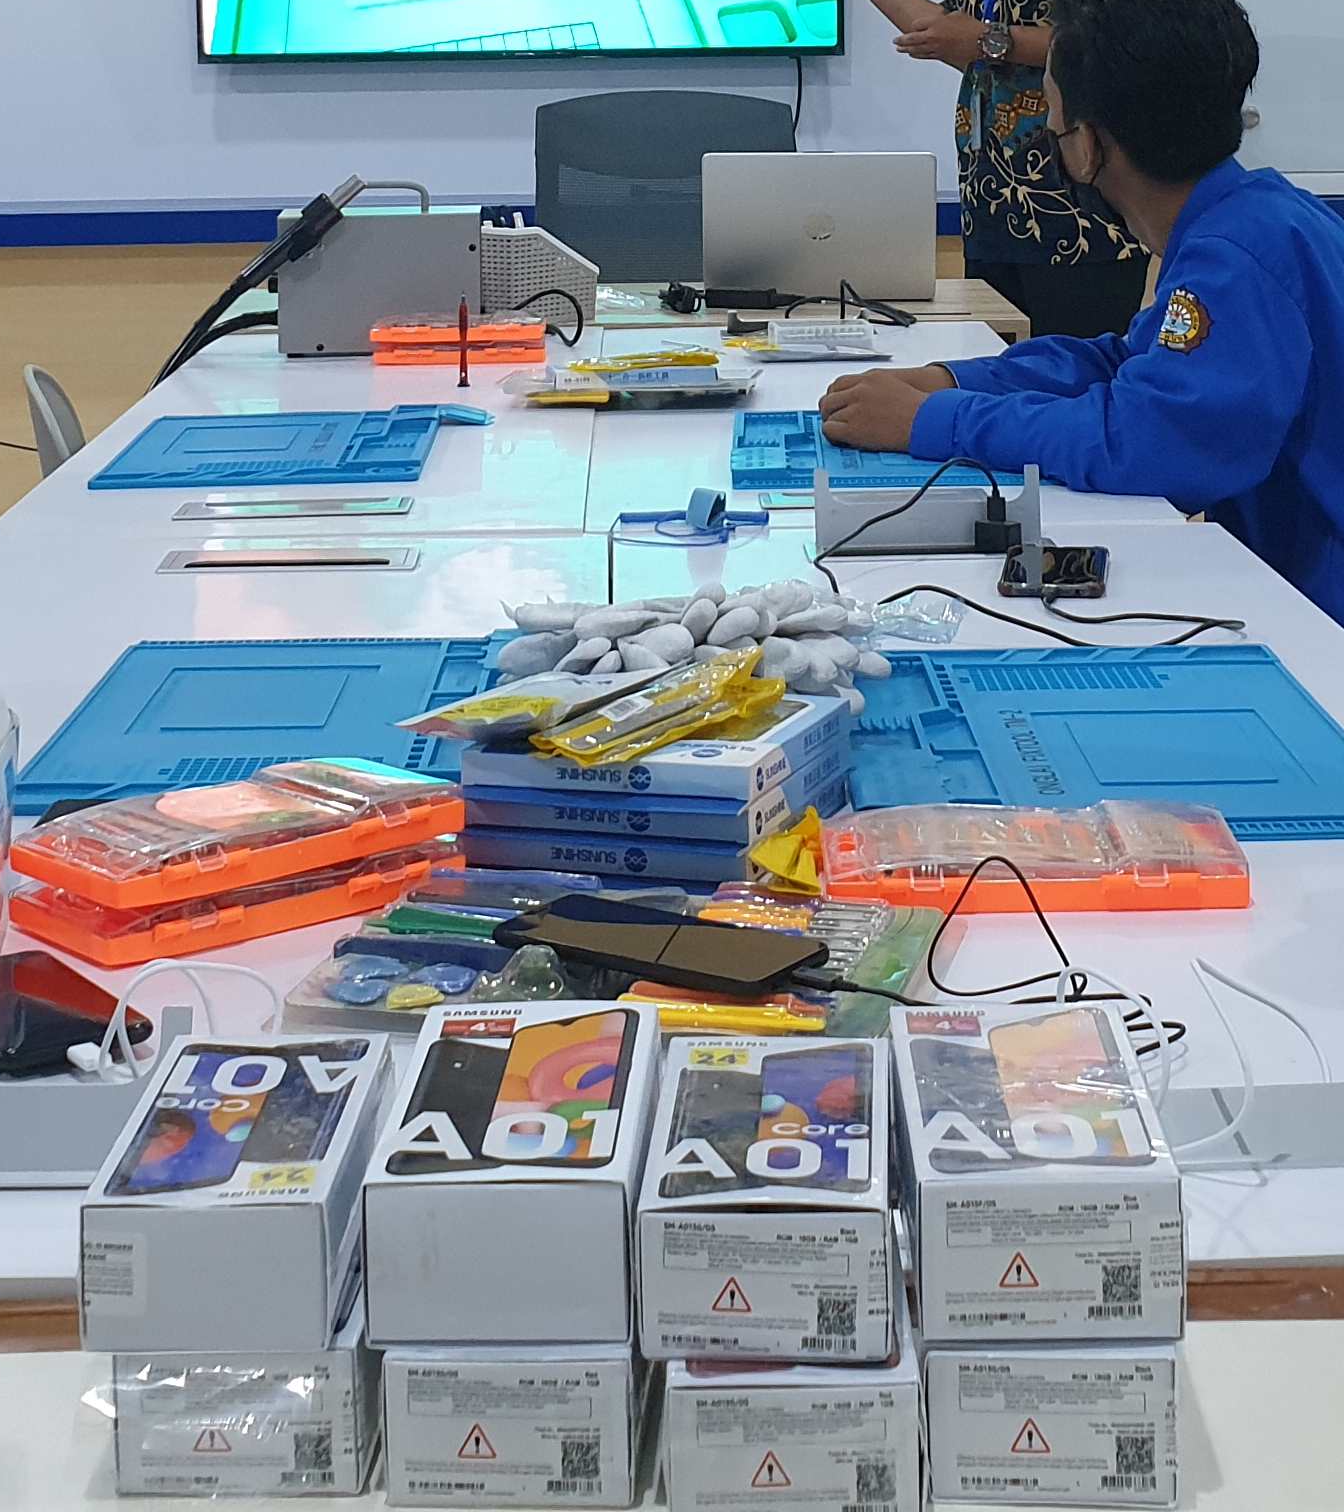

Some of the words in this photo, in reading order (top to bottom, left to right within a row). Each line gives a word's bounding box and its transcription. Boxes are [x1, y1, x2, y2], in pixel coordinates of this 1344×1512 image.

[555, 767, 622, 783] SUNSHINE
[553, 806, 621, 824] SUNSHINE
[550, 847, 617, 865] SUNSHINE
[442, 1009, 523, 1017] SAMSUNG
[158, 1054, 363, 1095] A01
[386, 1109, 622, 1161] A01
[770, 1121, 870, 1137] Core
[922, 1110, 1146, 1161] A01
[660, 1137, 870, 1180] A01
